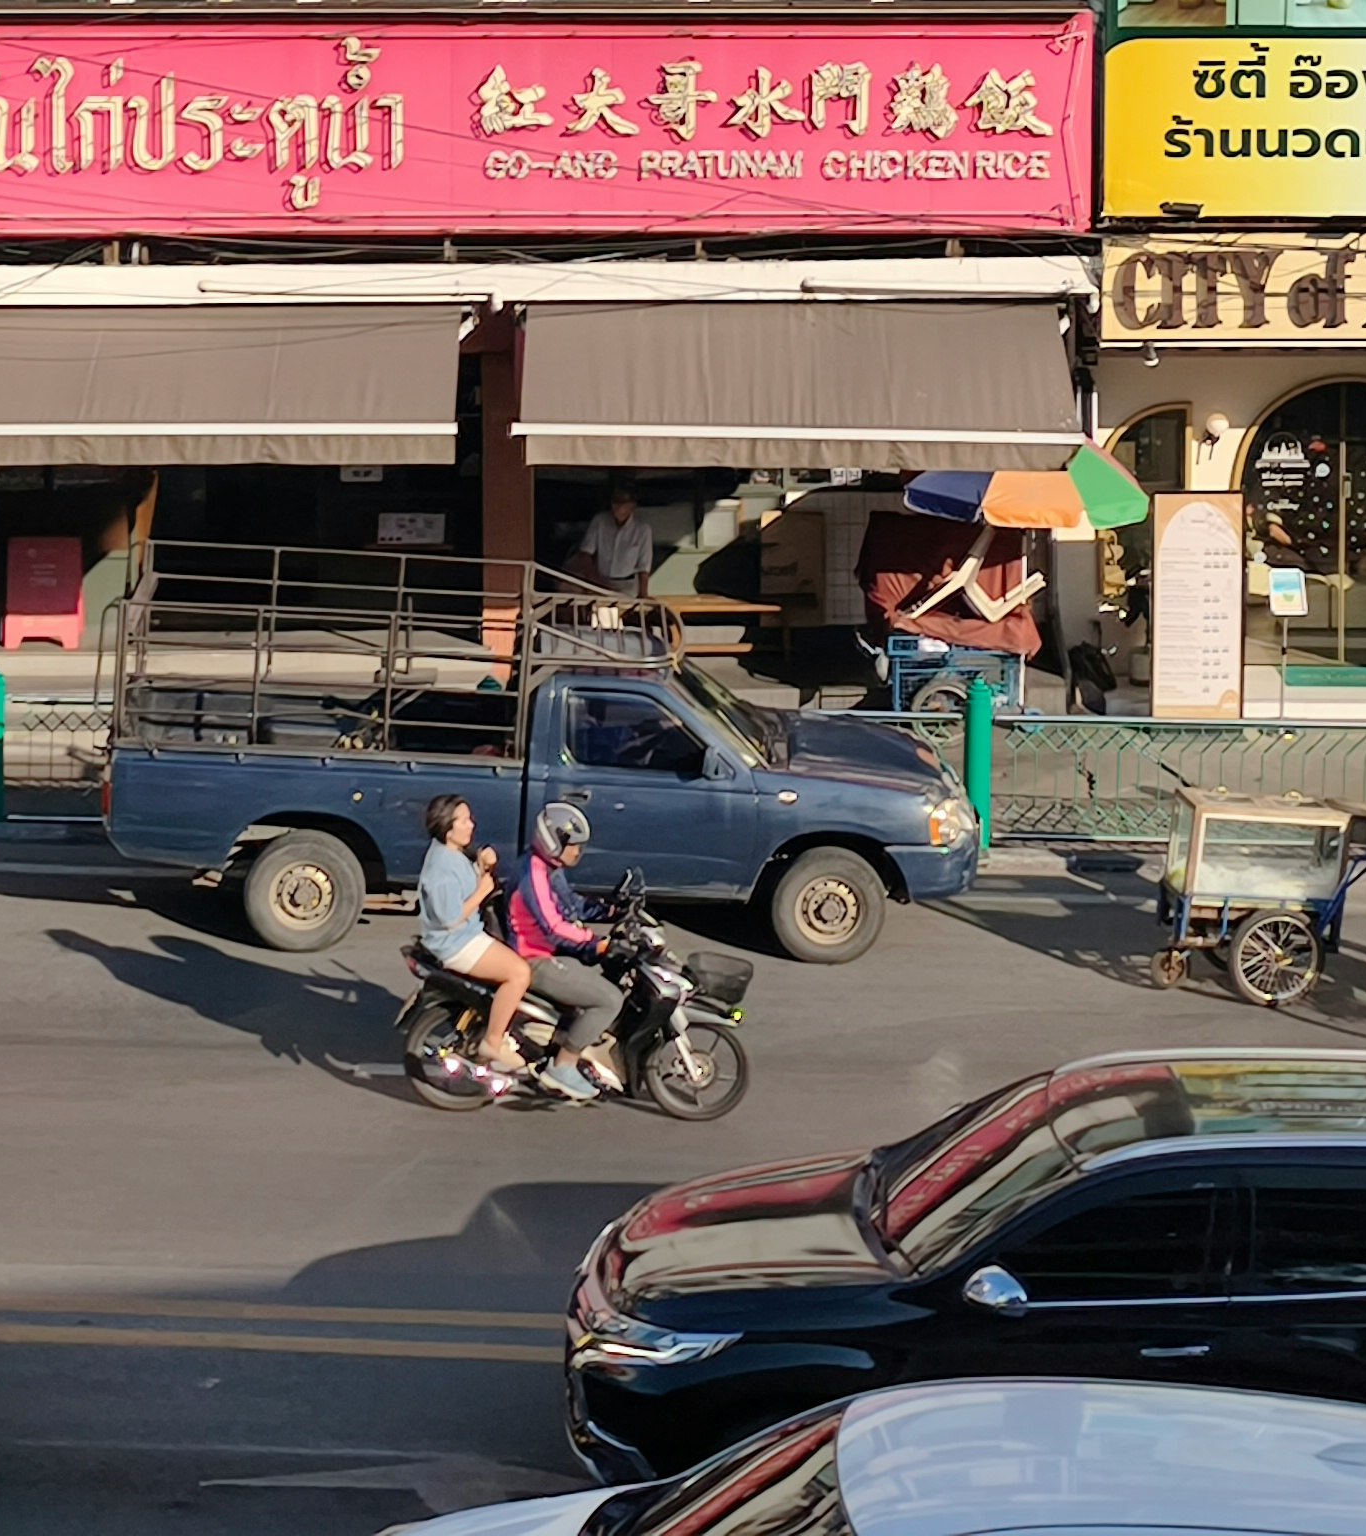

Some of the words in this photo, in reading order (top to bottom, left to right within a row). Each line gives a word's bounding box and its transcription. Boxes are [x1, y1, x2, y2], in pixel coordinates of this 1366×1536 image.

[1192, 42, 1270, 99] ซิตี้
[638, 148, 804, 180] PRATUNAM
[822, 149, 970, 180] CHICKEN
[973, 149, 1052, 180] RICE
[1112, 249, 1284, 331] CITY
[1287, 247, 1357, 329] of
